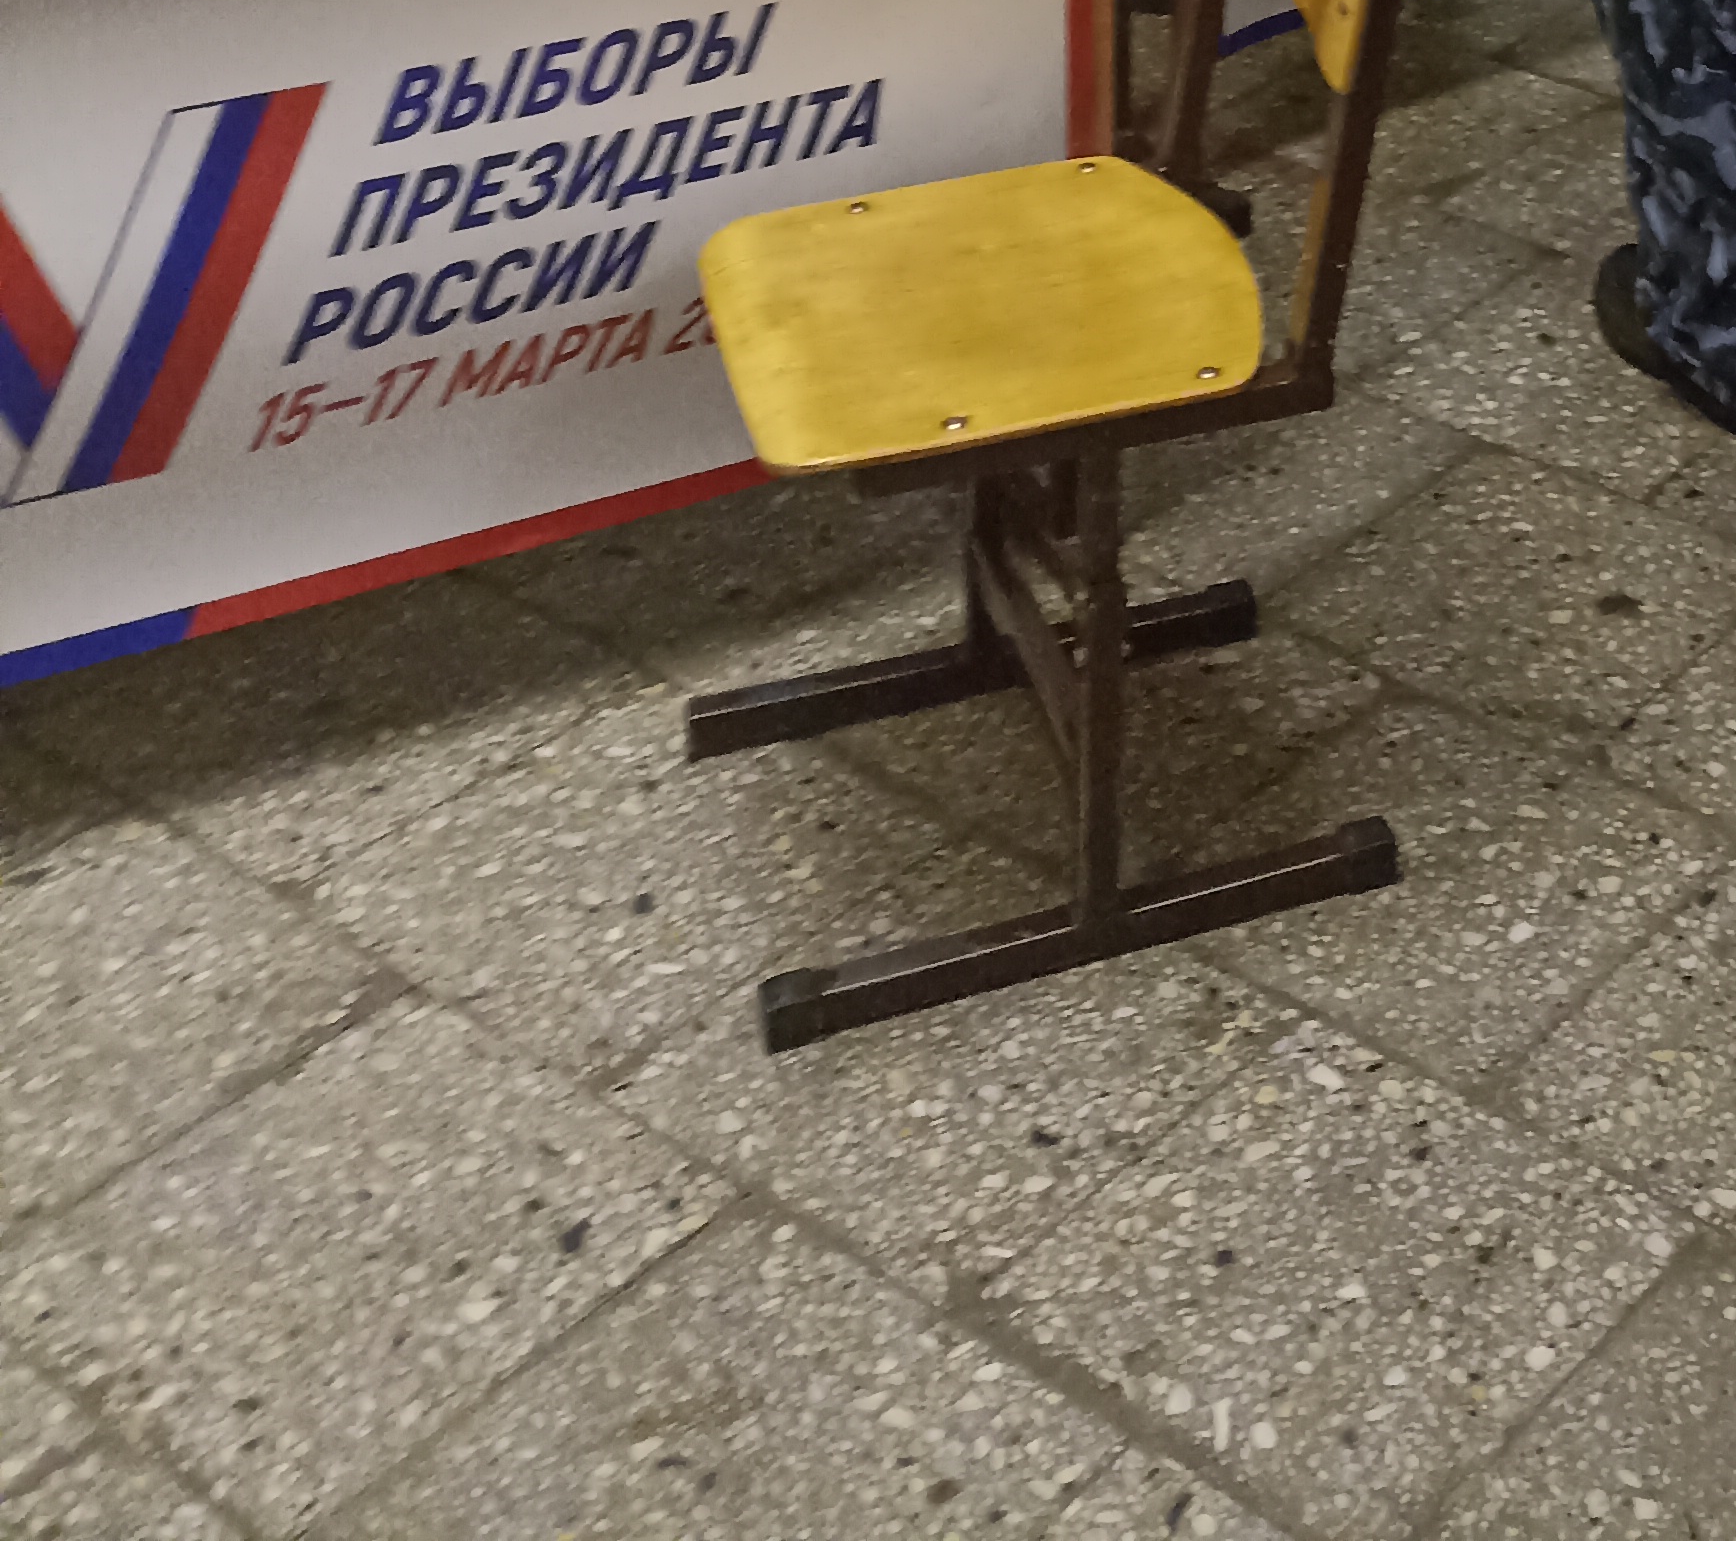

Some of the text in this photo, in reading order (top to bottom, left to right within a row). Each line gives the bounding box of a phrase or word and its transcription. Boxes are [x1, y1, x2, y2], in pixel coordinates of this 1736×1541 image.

[373, 2, 778, 146] ВЫБОРЫ
[328, 78, 884, 257] ПРЕЗИДЕНТА
[281, 220, 660, 367] РОССИИ
[440, 306, 658, 408] МАРТА
